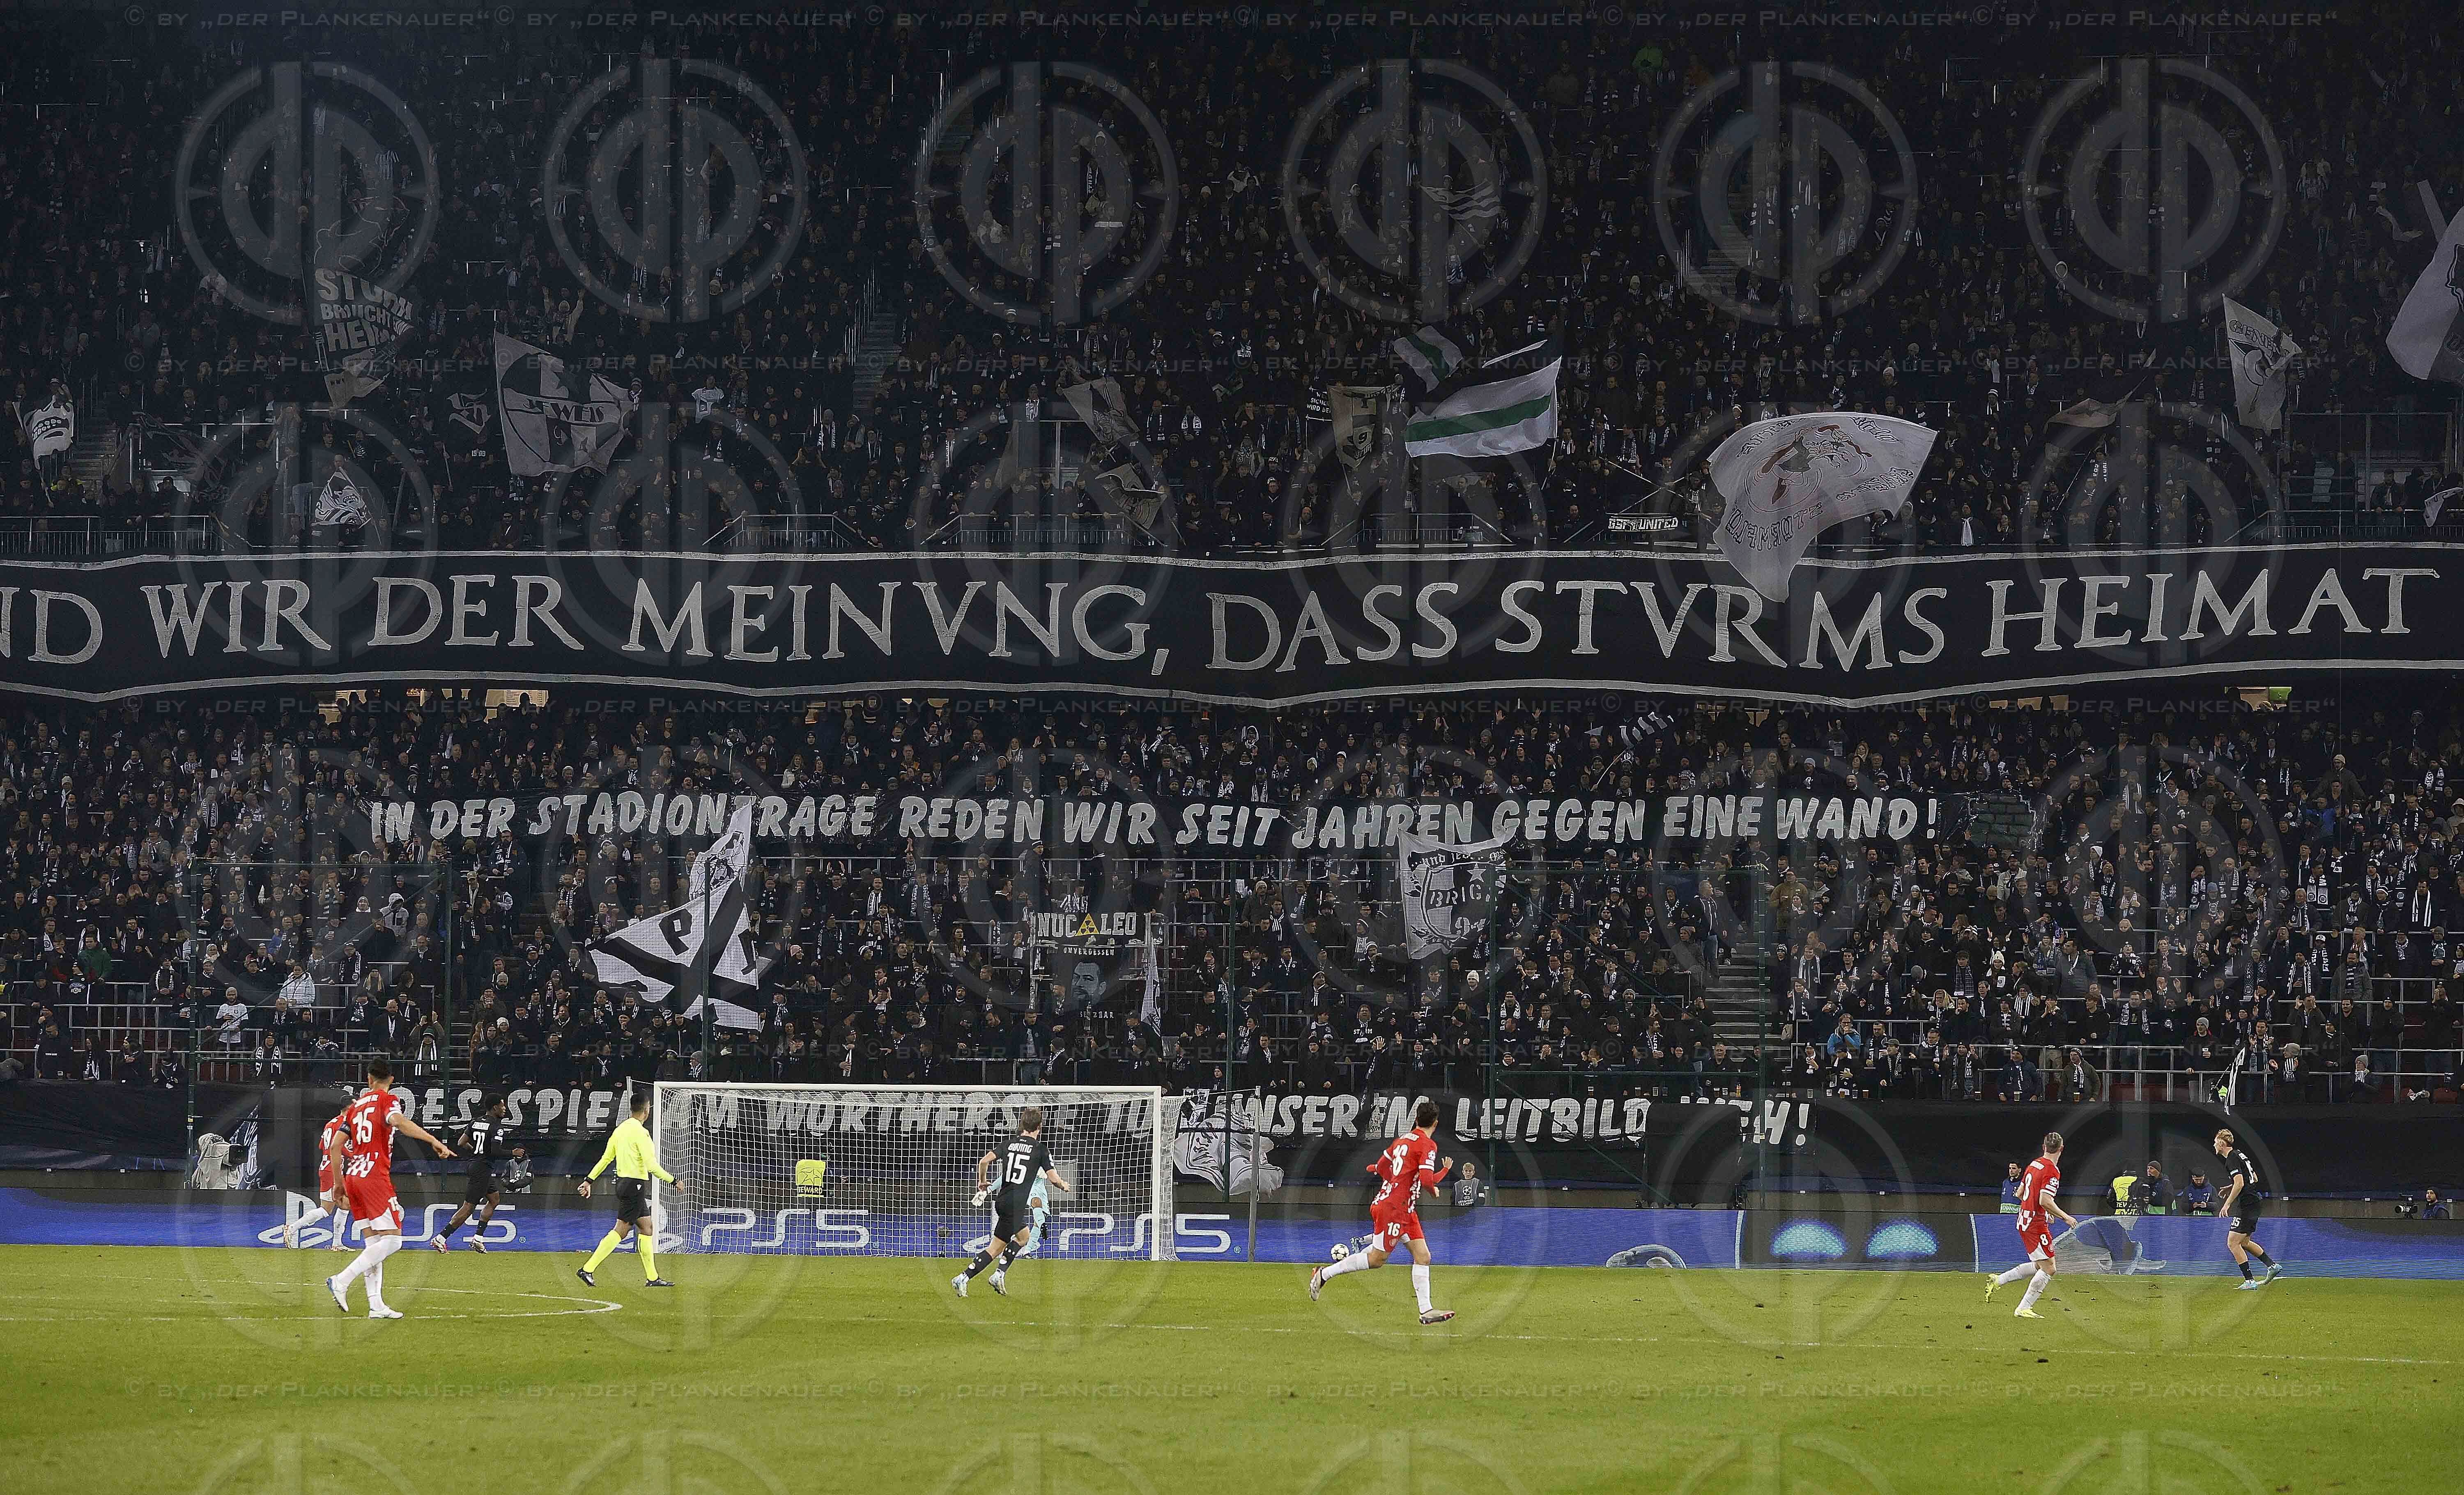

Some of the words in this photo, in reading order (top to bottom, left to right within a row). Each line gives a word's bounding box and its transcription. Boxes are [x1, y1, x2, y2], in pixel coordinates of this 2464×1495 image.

[1638, 517, 1678, 529] UNITED
[139, 578, 332, 659] WIR
[366, 574, 584, 652] DER
[621, 577, 1170, 677] MEINVNG,
[1204, 582, 1460, 674] DASS
[1981, 567, 2441, 658] HEIMAT
[371, 801, 415, 844] IN
[430, 797, 516, 840] DER
[529, 791, 877, 839] STADIONRAGE
[899, 795, 1044, 843] REDEN
[1064, 800, 1157, 845] WIR
[1175, 802, 1280, 848] SEIT
[1291, 800, 1474, 850] JAHREN
[1492, 797, 1647, 844] GEGEN
[1663, 794, 1765, 840] EINE
[1776, 796, 1938, 840] WAND!
[1063, 947, 1115, 956] UNVERGESSEN
[352, 1107, 375, 1145] 15
[1455, 1096, 1653, 1143] LEITBILD
[1005, 1152, 1030, 1185] 15
[1392, 1144, 1409, 1176] 16
[2023, 1173, 2032, 1201] 8
[702, 1208, 870, 1248] PS5
[1059, 1213, 1231, 1254] PS5
[1387, 1222, 1401, 1237] 16
[2040, 1233, 2048, 1246] 8
